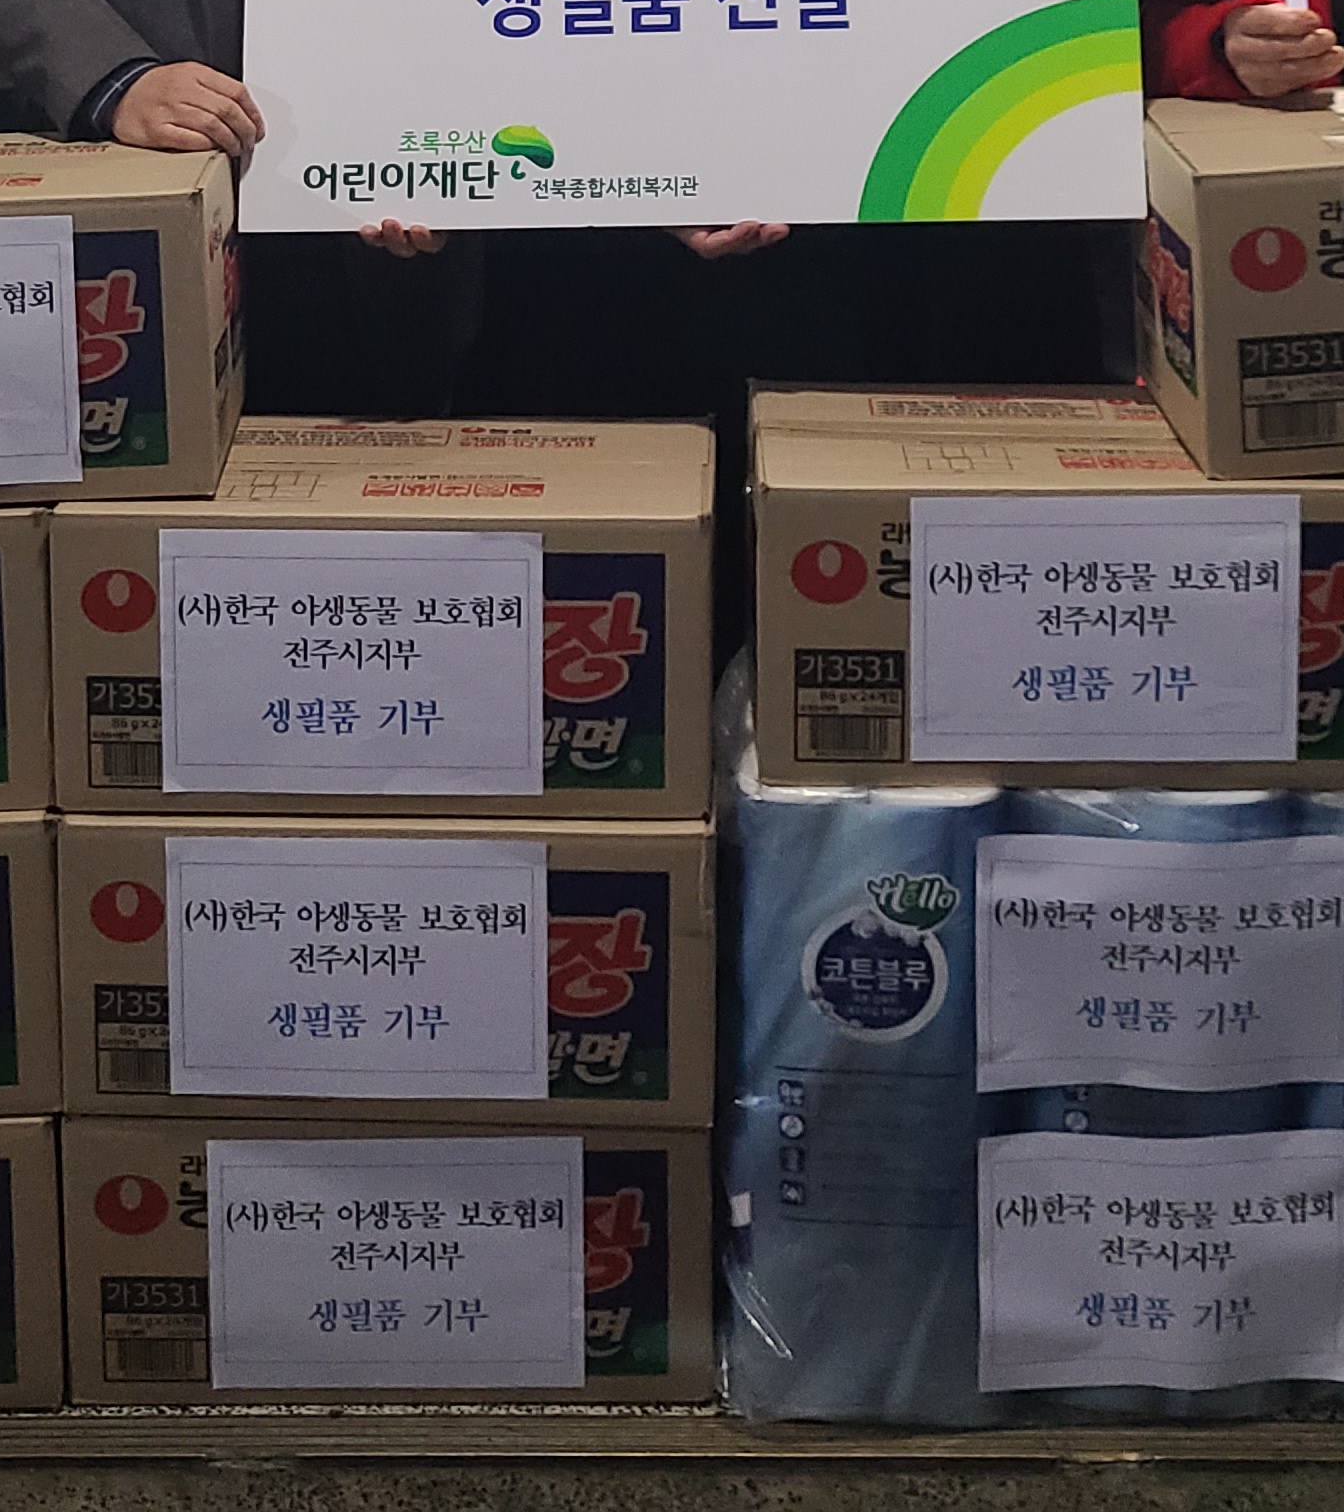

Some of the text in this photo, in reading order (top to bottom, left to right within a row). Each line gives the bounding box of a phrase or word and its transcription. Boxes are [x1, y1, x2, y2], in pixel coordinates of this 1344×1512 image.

[398, 131, 486, 155] 초록우산
[304, 160, 499, 201] 어린이재단
[532, 176, 698, 199] 전북종합사회복지관
[1246, 342, 1344, 372] 가3531
[930, 560, 1278, 594] (사)한국 야생동물 보호협회
[179, 594, 521, 628] (사)한국 야생동물 보호협회
[1037, 605, 1176, 636] 전주시지부
[284, 638, 421, 670] 전주시지부
[800, 656, 900, 683] 가3531
[1013, 665, 1197, 702] 생필품 기부
[262, 698, 444, 735] 생필품 기부
[869, 877, 955, 912] Hello
[185, 900, 526, 934] (사)한국 야생동물 보호협회
[995, 897, 1341, 933] (사)한국 야생동물 보호협회
[290, 944, 425, 976] 전주시지부
[821, 957, 930, 992] 코튼블루
[1101, 942, 1240, 974] 전주시지부
[268, 1003, 449, 1040] 생필품 기부
[1077, 996, 1261, 1035] 생필품 기부
[227, 1198, 563, 1232] (사)한국 야생동물 보호협회
[996, 1190, 1334, 1230] (사)한국 야생동물 보호협회
[331, 1241, 464, 1271] 전주시지부
[1100, 1236, 1236, 1272] 전주시지부
[107, 1283, 201, 1309] 가3531
[1077, 1293, 1256, 1333] 생필품 기부
[309, 1299, 488, 1332] 생필품 기부
